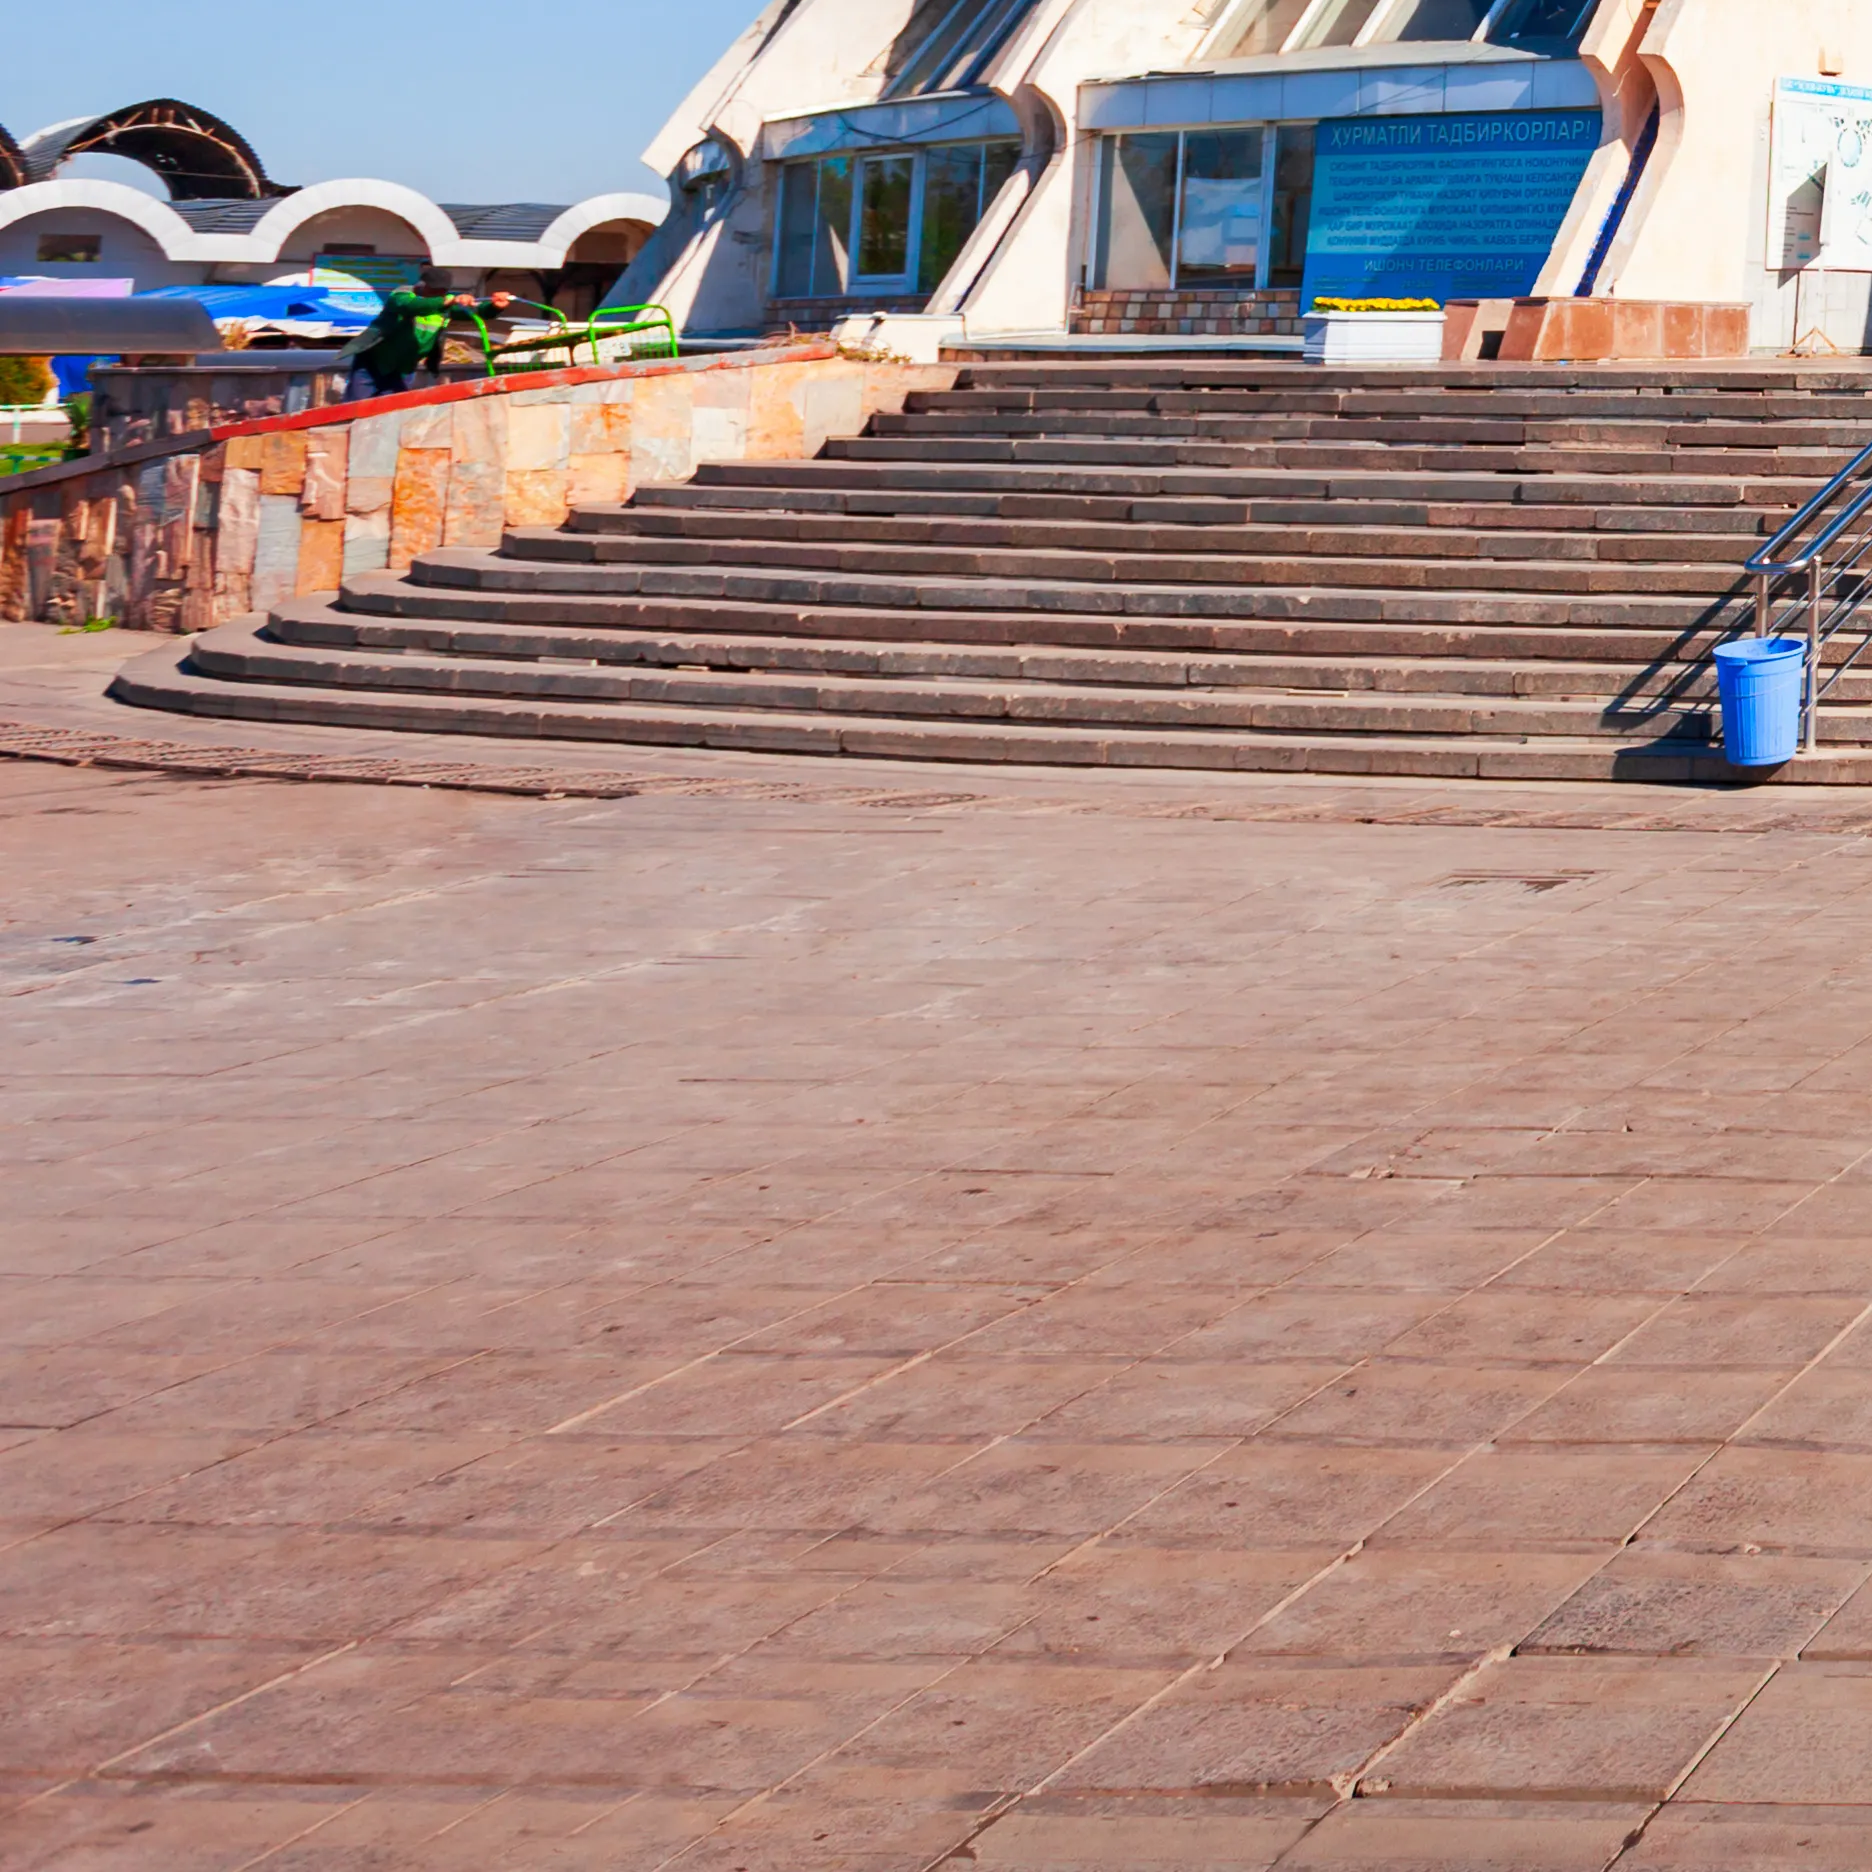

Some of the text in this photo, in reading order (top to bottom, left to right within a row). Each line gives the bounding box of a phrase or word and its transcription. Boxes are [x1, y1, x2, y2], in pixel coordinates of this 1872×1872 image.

[1330, 120, 1591, 148] ҲУРМАТЛИ ТАДБИРКОРЛАР!
[1364, 259, 1414, 272] ИШОНЧ
